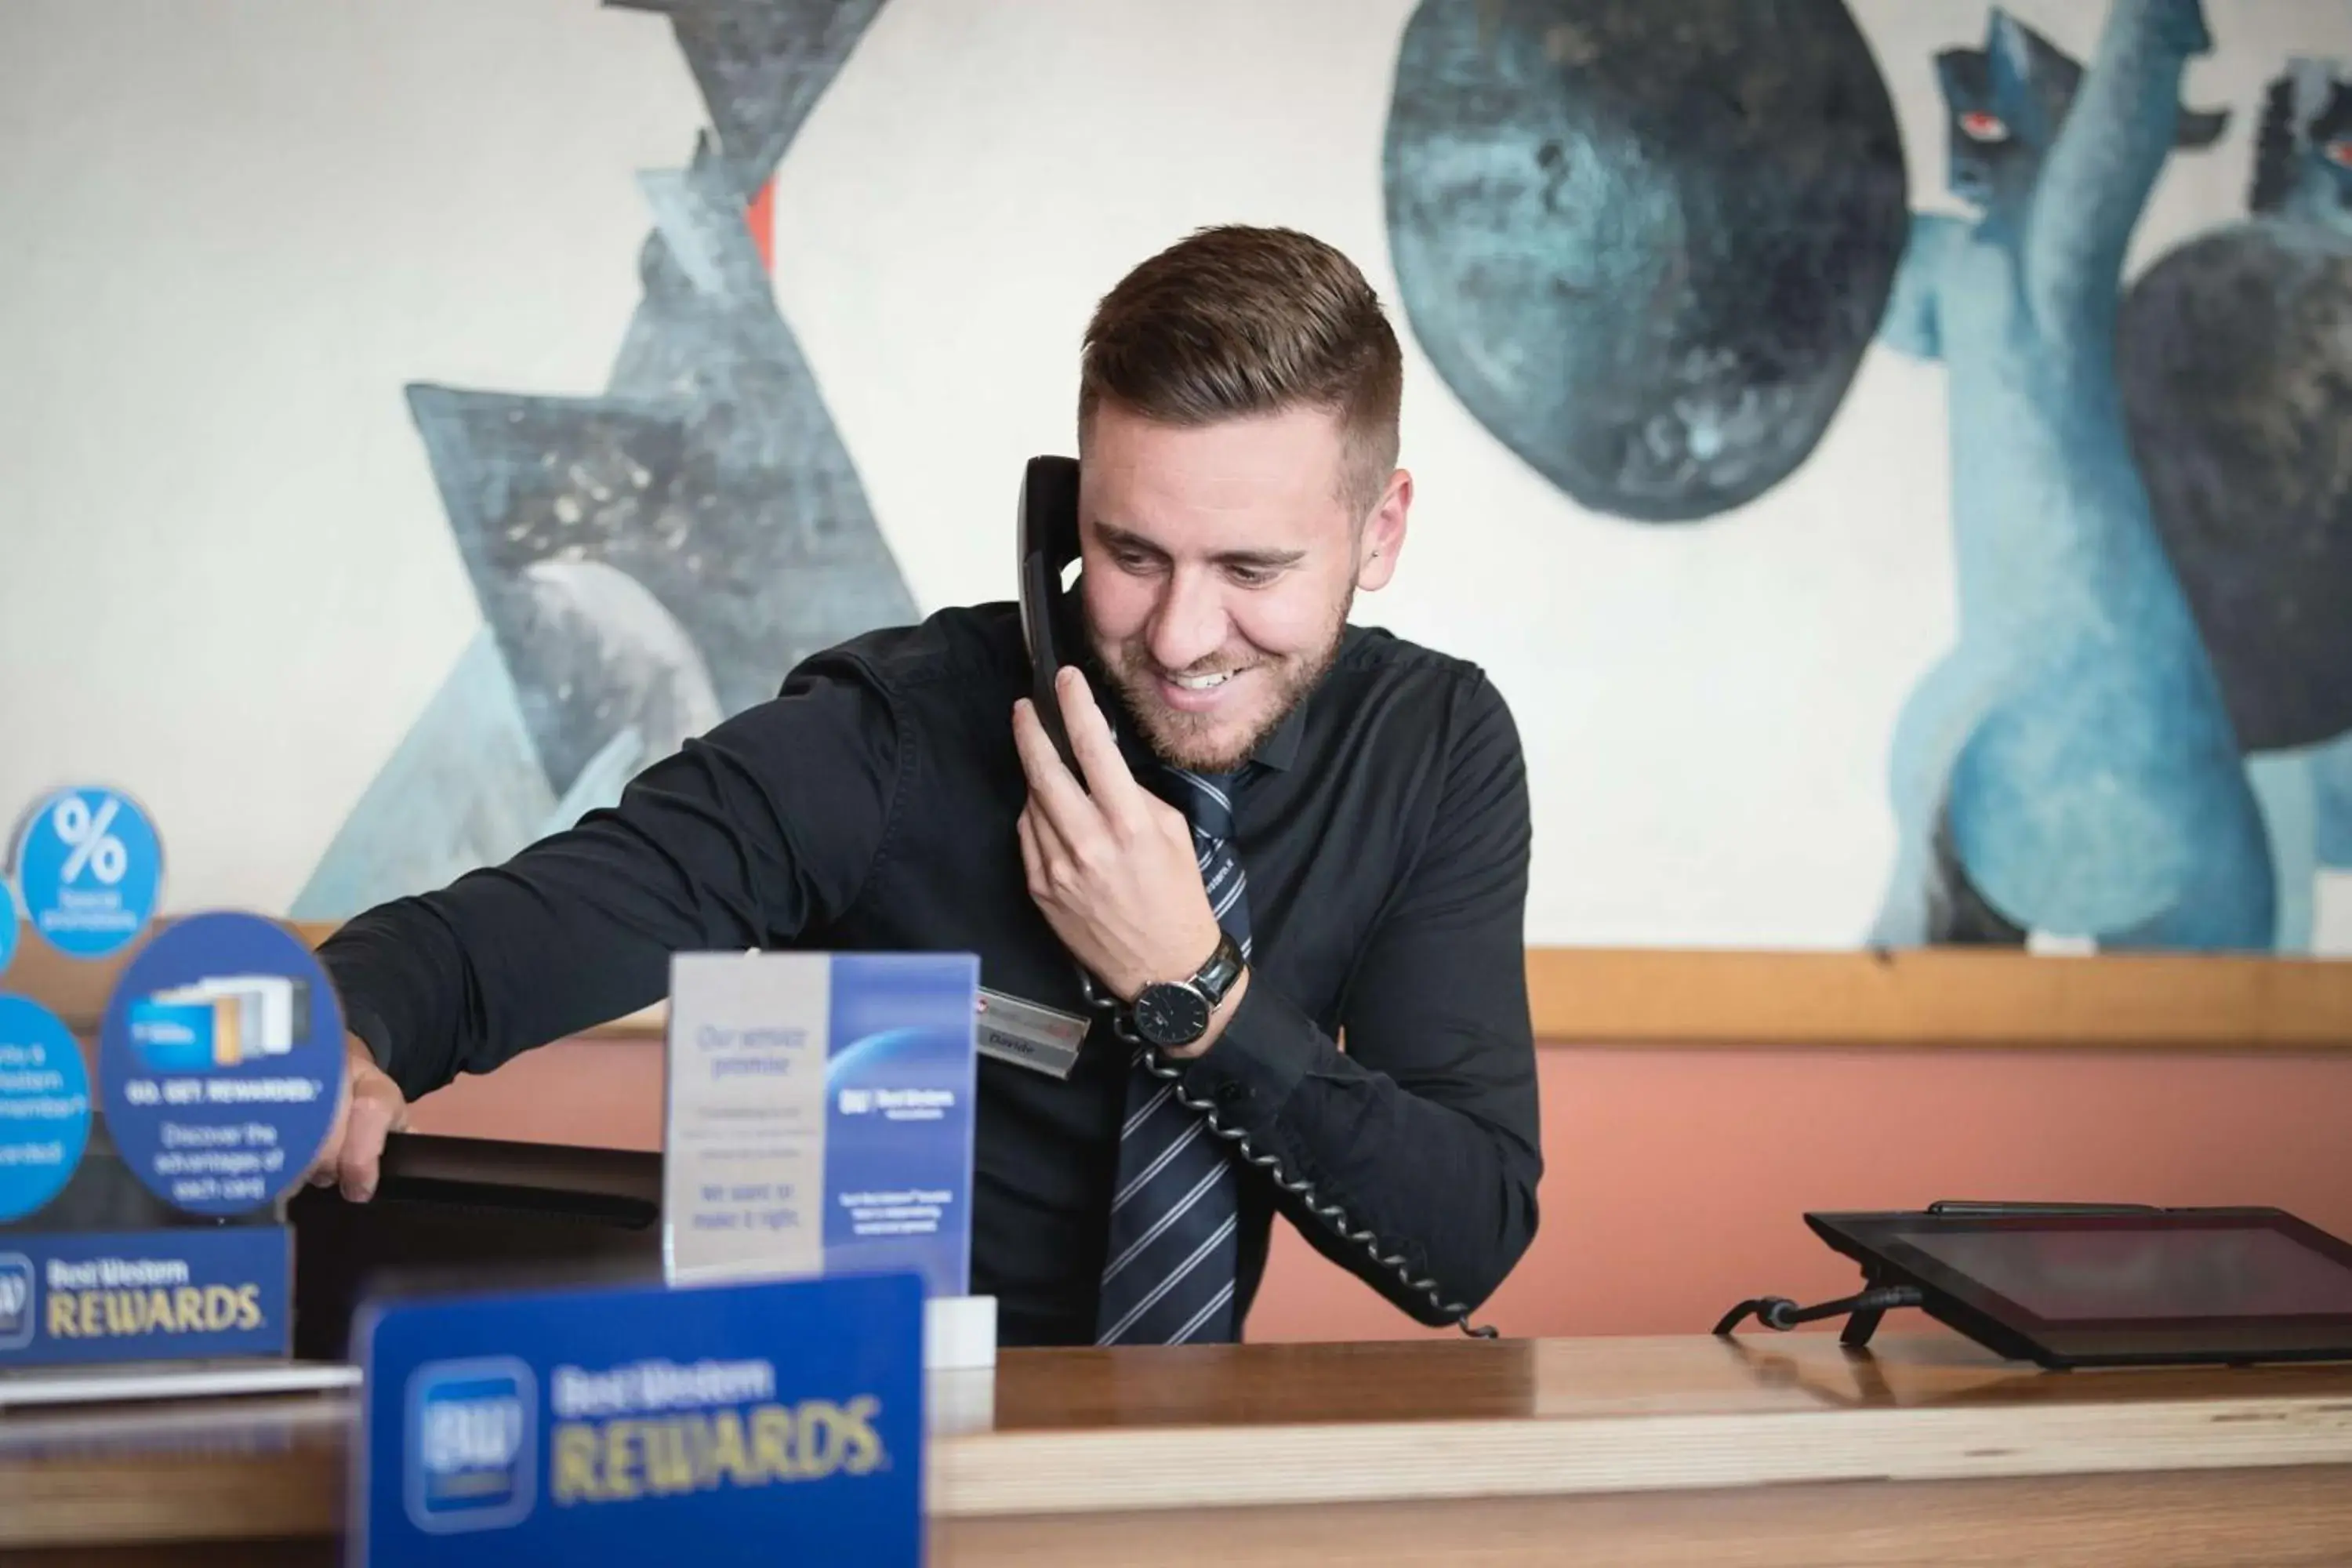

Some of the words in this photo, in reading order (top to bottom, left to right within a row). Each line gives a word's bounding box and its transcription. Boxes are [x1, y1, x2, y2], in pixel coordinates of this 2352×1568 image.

[989, 1033, 1034, 1054] Davide
[47, 1259, 97, 1288] Best
[100, 1259, 188, 1286] Western
[48, 1284, 262, 1336] REWARDS
[554, 1365, 627, 1417] Best
[632, 1359, 775, 1409] Western
[552, 1395, 884, 1505] REWARDS
